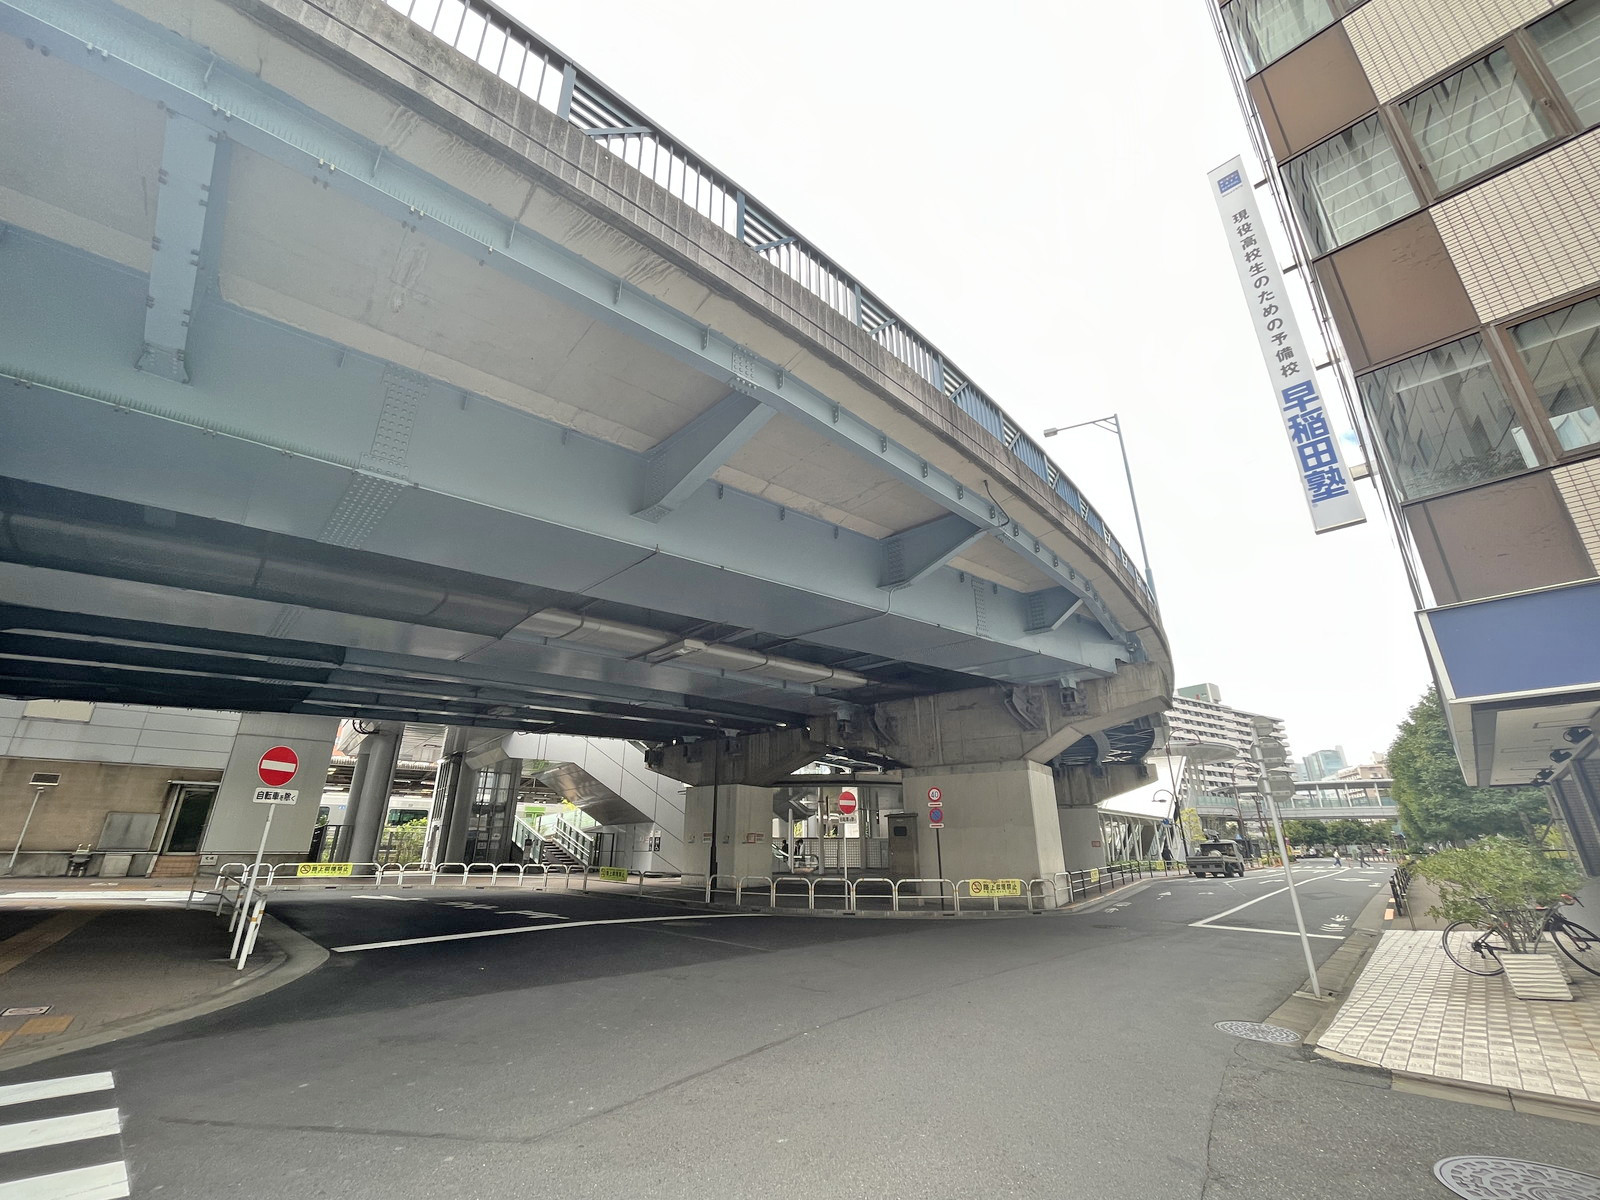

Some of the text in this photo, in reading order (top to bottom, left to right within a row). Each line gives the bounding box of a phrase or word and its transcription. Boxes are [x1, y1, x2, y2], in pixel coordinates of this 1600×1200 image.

[1231, 208, 1301, 378] 現役高校生のための予備校
[1282, 380, 1349, 503] 早稲田塾
[256, 791, 296, 802] 自転車を除く
